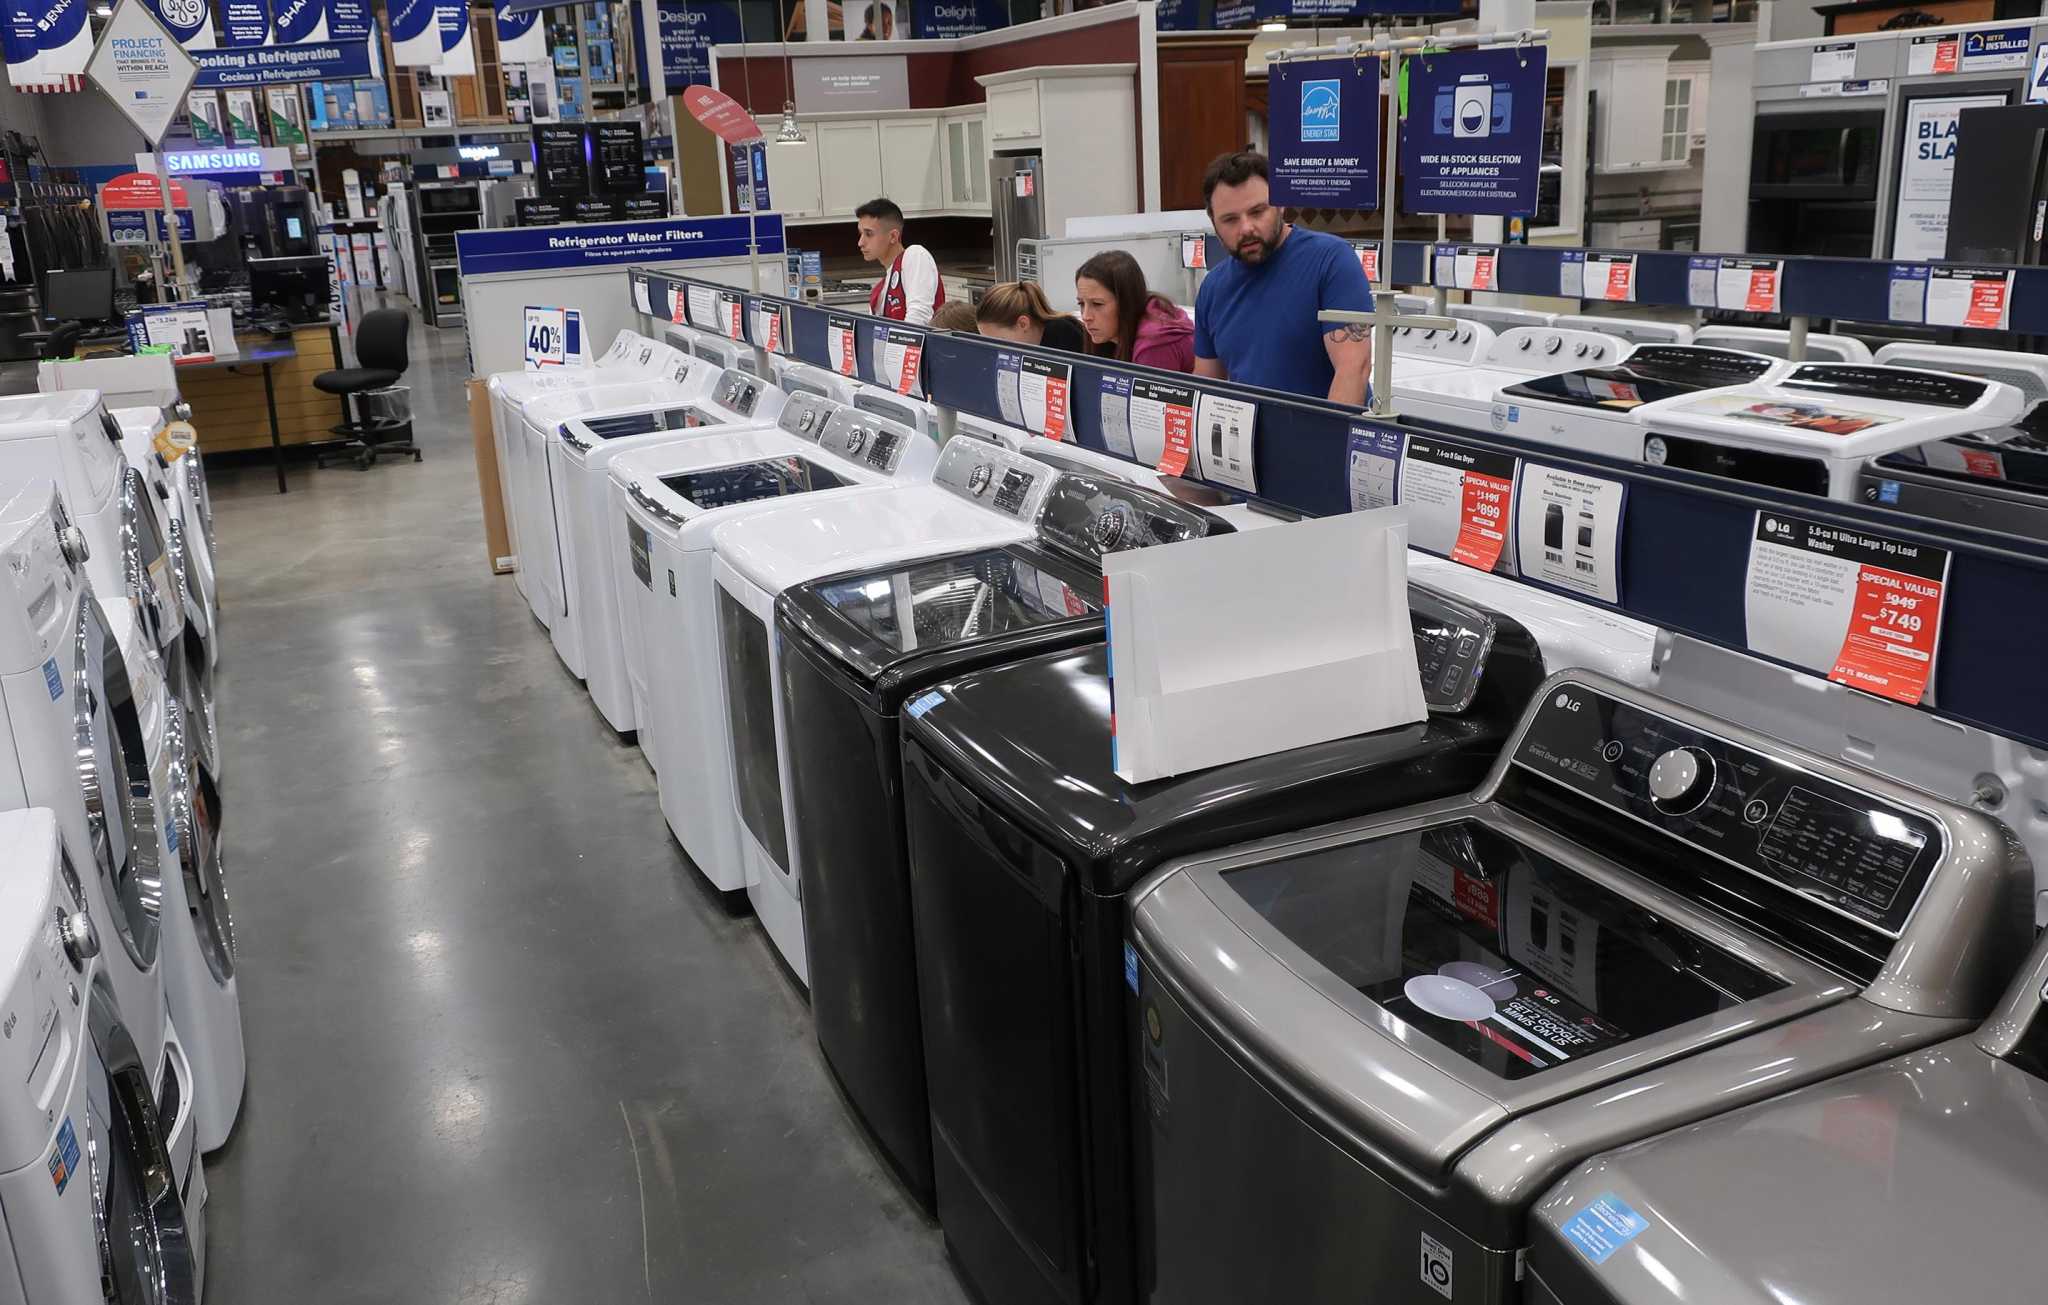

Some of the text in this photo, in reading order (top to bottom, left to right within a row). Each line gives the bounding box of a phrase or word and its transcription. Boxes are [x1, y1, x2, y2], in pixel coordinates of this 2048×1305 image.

[658, 10, 706, 25] Design
[934, 5, 976, 18] Delight
[112, 39, 162, 49] PROJECT
[1986, 39, 2028, 51] INSTALLED
[113, 49, 166, 58] FINANCING
[248, 53, 257, 64] &
[258, 48, 340, 63] Refrigeration
[219, 71, 255, 82] Cocinas
[1918, 120, 1960, 139] BLA
[1918, 142, 1957, 160] SLA
[167, 151, 261, 170] SAMSUNG
[1284, 158, 1299, 166] SAVE
[1301, 158, 1326, 166] ENERGY
[1334, 158, 1359, 166] MONEY
[1420, 155, 1521, 164] WIDE IN-STOCK SELECTION
[1440, 167, 1500, 176] OF APPLIANCES
[548, 230, 704, 248] Refrigerator Water Filters
[528, 325, 561, 354] 40%
[550, 346, 561, 354] OFF
[1352, 427, 1376, 438] SAMSUNG
[1454, 453, 1462, 461] Gas
[1463, 454, 1475, 465] Dryer
[1466, 476, 1488, 488] SPECIAL
[1477, 490, 1500, 502] $1199
[1477, 502, 1500, 519] $899
[1777, 523, 1791, 533] LG
[1832, 531, 1839, 540] ft
[1839, 532, 1857, 544] Ultra
[1859, 536, 1880, 550] Large
[1882, 541, 1896, 554] Top
[1898, 545, 1918, 557] Load
[1808, 537, 1835, 552] Washer
[1862, 572, 1902, 589] SPECIAL
[1885, 592, 1917, 610] $949
[1880, 608, 1922, 632] $749
[1835, 665, 1846, 673] LG
[1856, 671, 1888, 686] WASHER
[1567, 699, 1581, 712] LG
[1544, 995, 1560, 1005] LG
[9, 1011, 17, 1029] LG
[1502, 1007, 1570, 1046] MINIS ON US
[1509, 1001, 1584, 1045] GET 2 GOOGLE
[1424, 1252, 1449, 1286] 10
